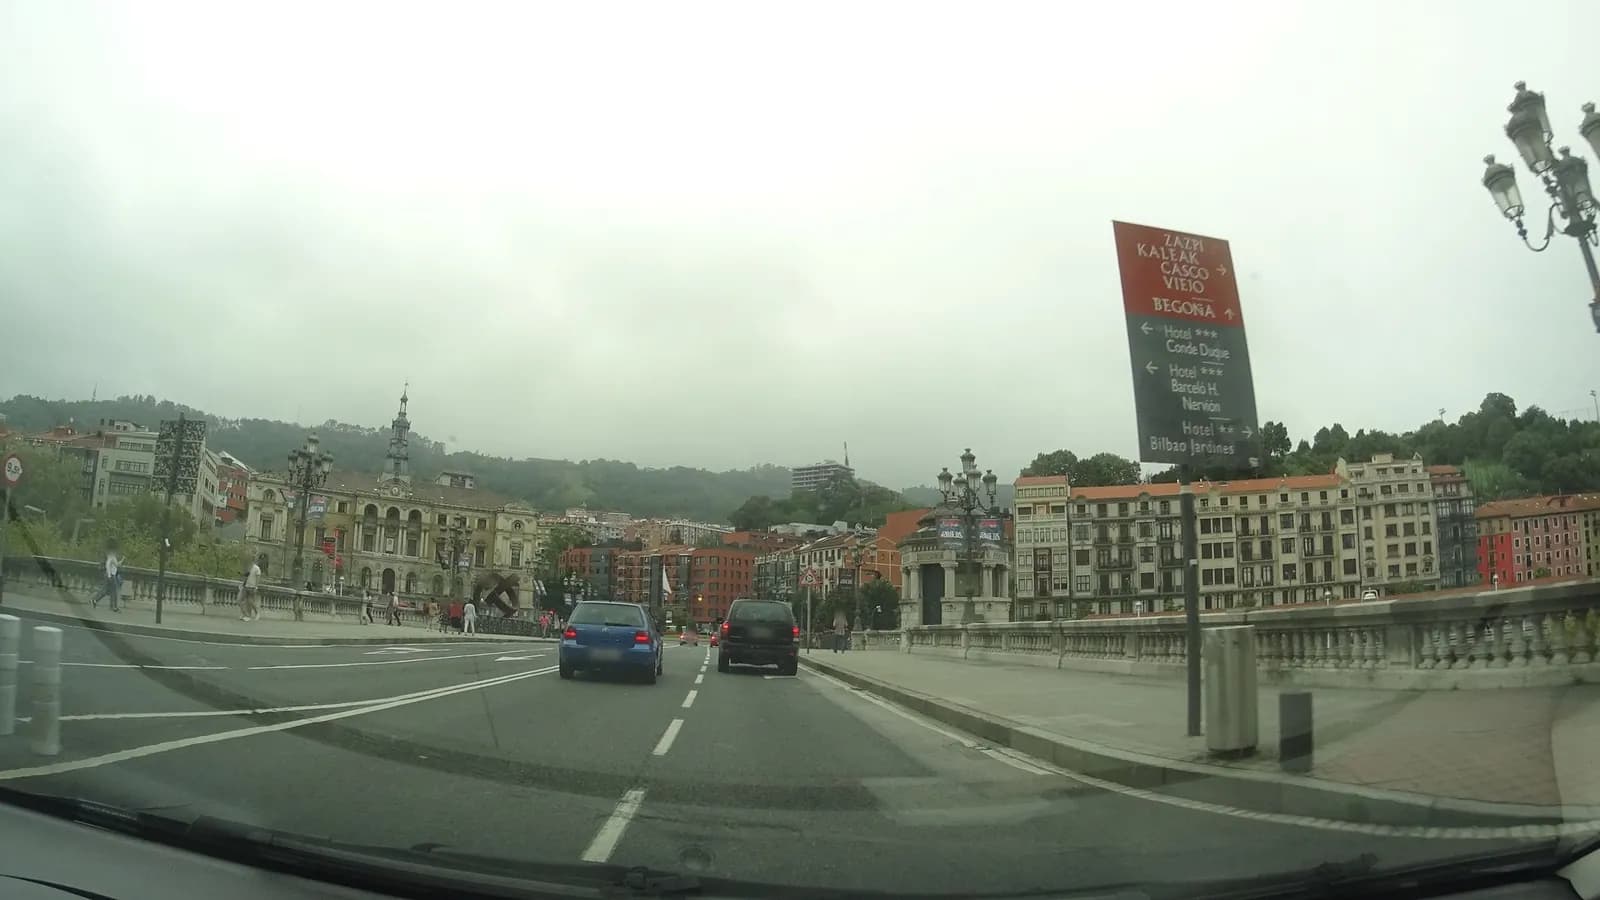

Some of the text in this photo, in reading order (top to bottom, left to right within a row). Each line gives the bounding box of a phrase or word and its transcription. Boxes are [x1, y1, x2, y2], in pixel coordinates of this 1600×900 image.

[1163, 233, 1205, 252] ZAZPI
[1136, 243, 1200, 265] KALEAK
[1160, 262, 1210, 280] CASCO
[1162, 276, 1205, 293] VIEJO
[1152, 297, 1217, 318] BEGOÑA
[1164, 324, 1193, 340] Hotel
[1166, 339, 1231, 360] Conde Duque
[1169, 363, 1197, 379] Hotel
[1182, 396, 1221, 412] Nervión
[1182, 420, 1215, 436] Hotel
[1149, 436, 1235, 456] Bilbao Jardines
